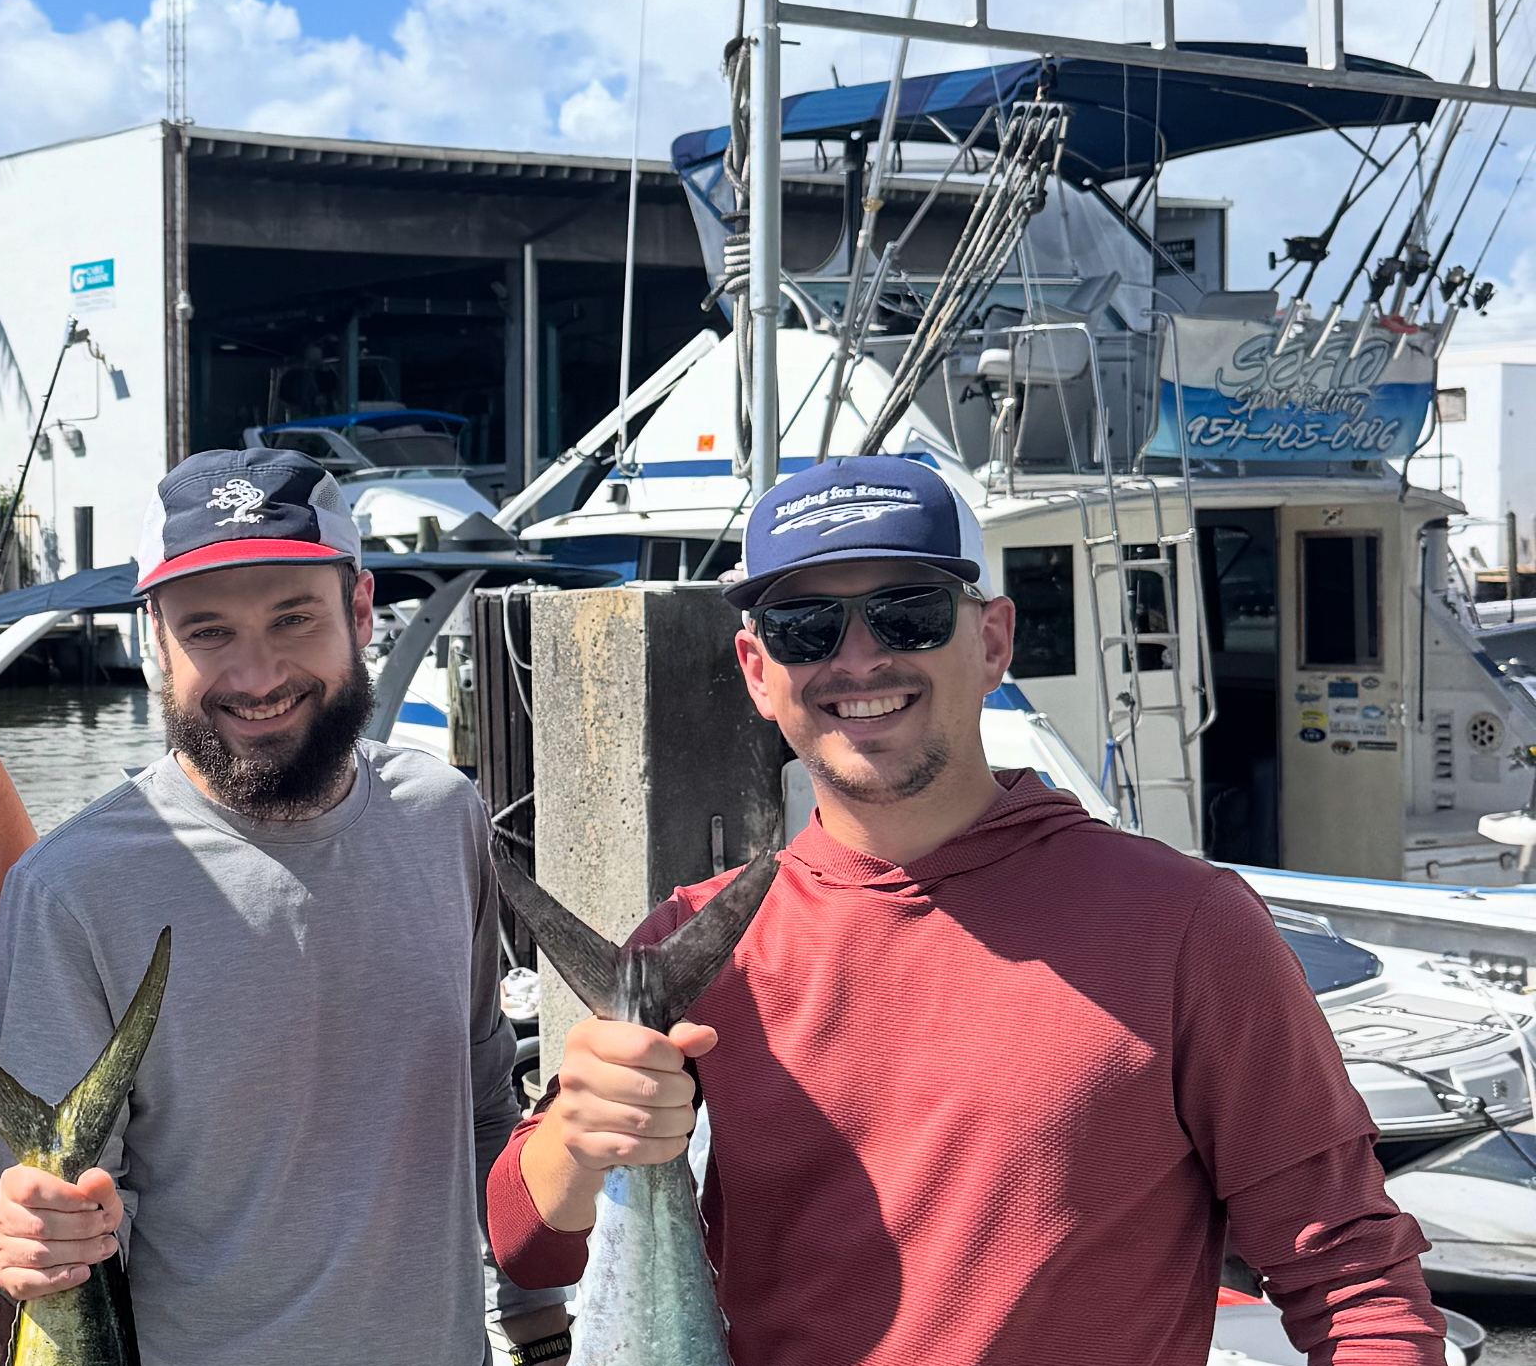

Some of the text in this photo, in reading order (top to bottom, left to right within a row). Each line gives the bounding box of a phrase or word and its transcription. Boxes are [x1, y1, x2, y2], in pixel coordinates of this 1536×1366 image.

[1187, 415, 1400, 452] 954-405-0986
[775, 484, 913, 518] Rigging for Rescue
